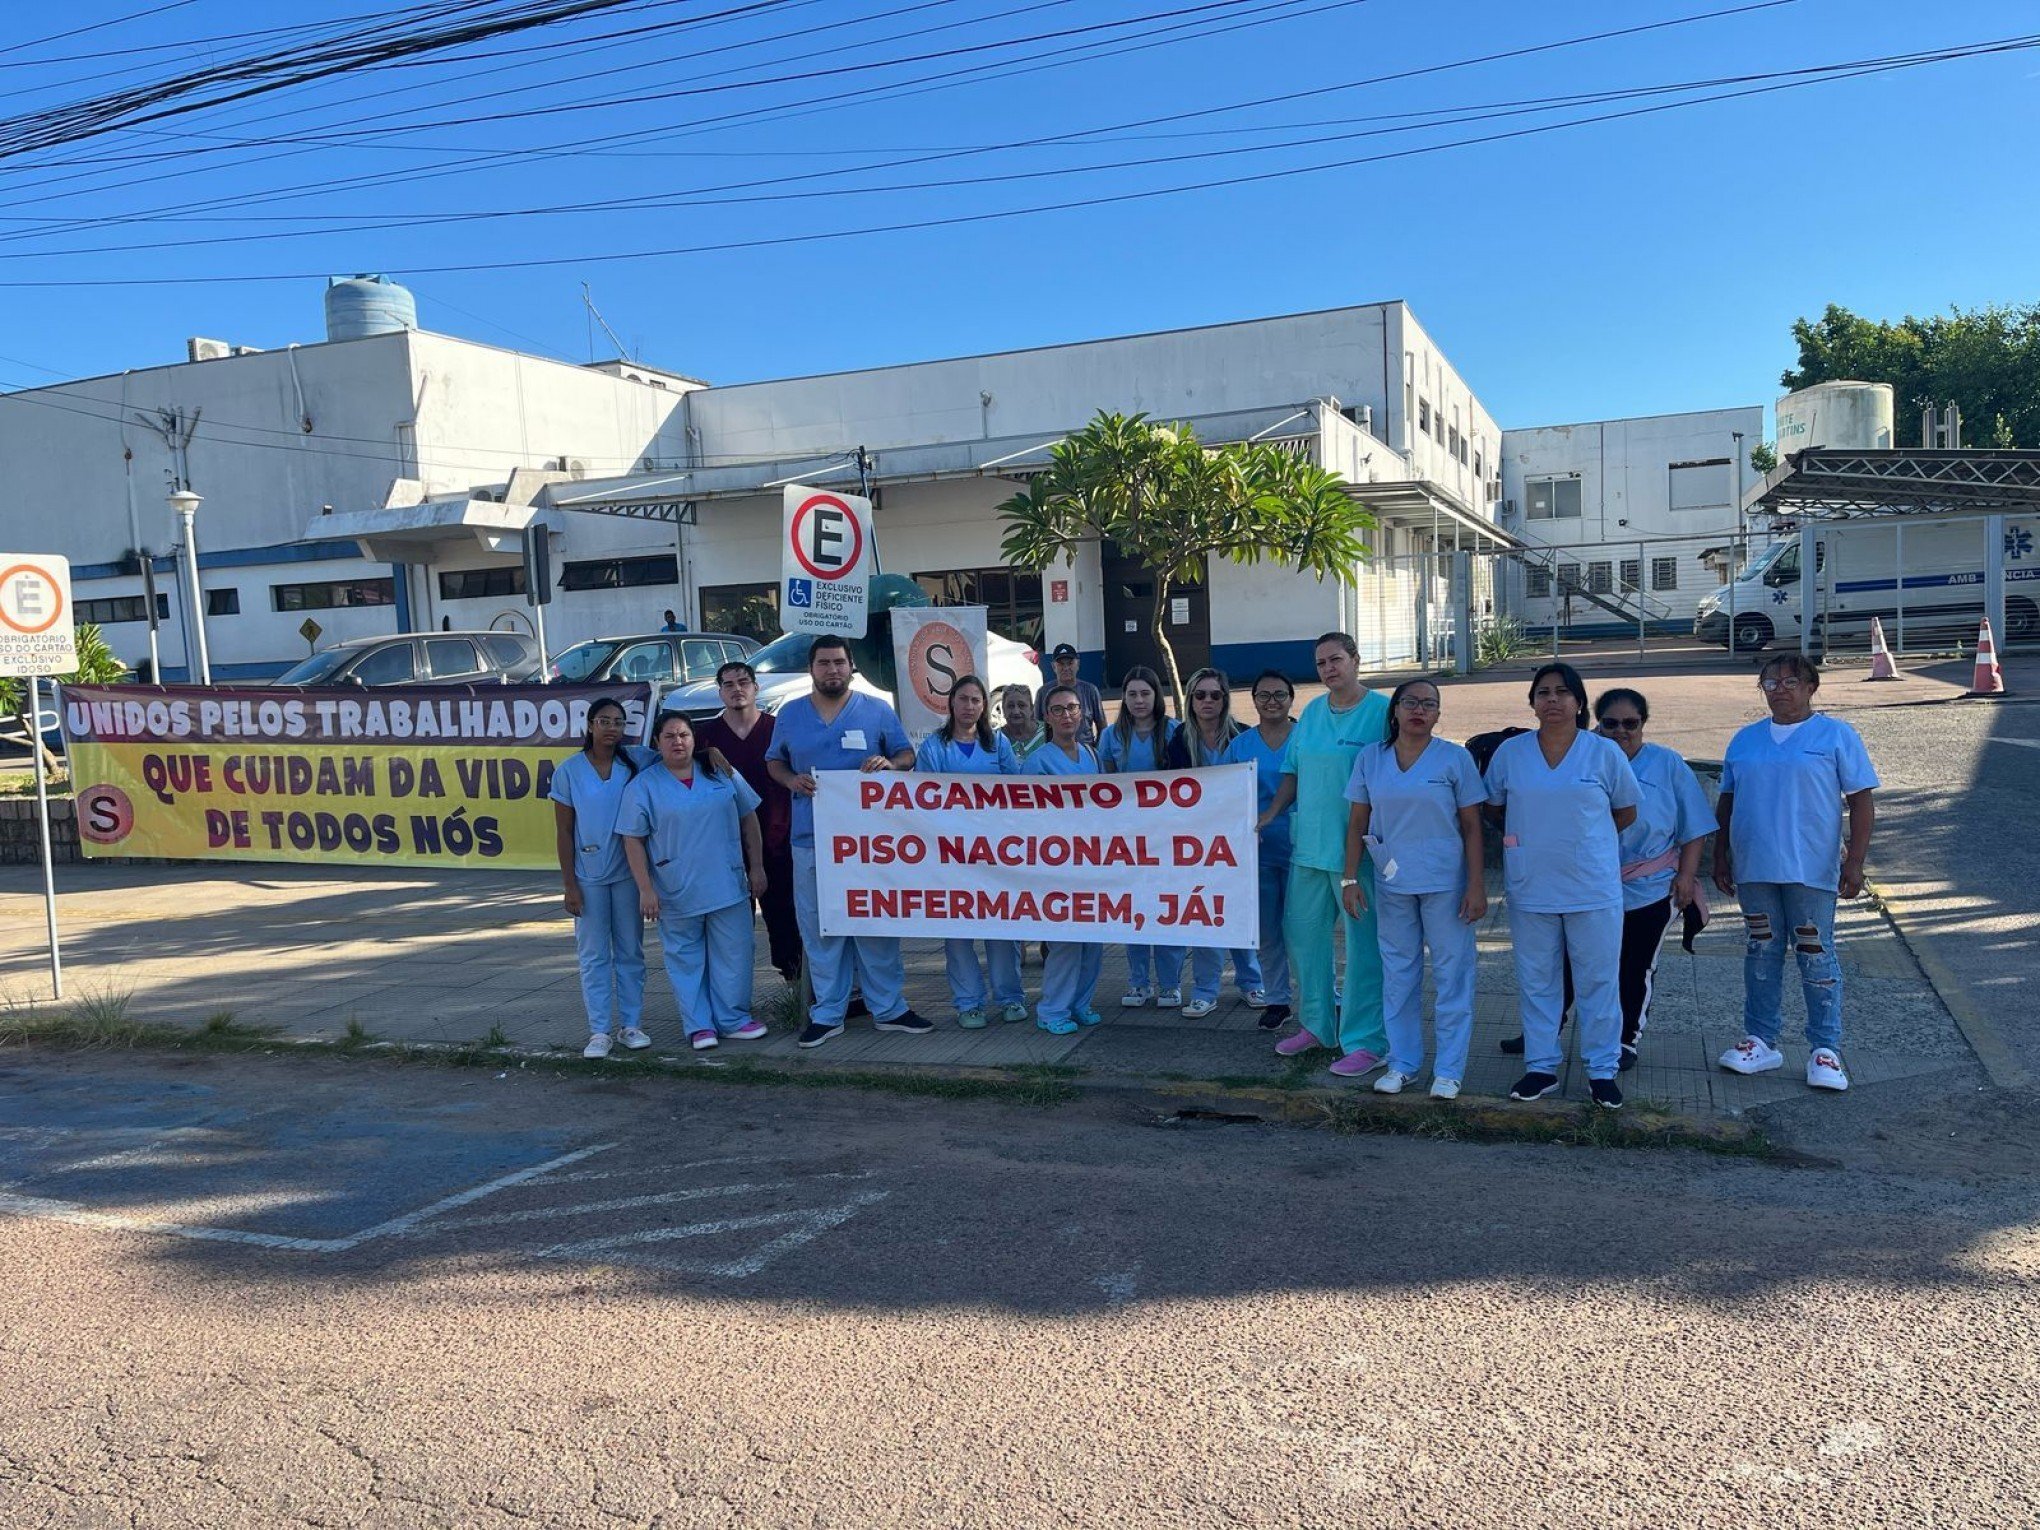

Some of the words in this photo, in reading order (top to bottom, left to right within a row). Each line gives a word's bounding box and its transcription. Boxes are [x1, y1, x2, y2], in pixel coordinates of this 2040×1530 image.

[813, 509, 843, 565] E
[816, 581, 863, 594] EXCLUSIVO
[1948, 570, 2036, 585] AMBNCIA
[15, 580, 42, 614] E
[815, 591, 864, 604] DEFICIENTE
[0, 644, 12, 653] SO
[16, 644, 31, 653] DO
[3, 654, 62, 664] EXCLUSIVO
[17, 664, 52, 674] IDOSO
[926, 643, 957, 696] S
[67, 700, 191, 737] UNIDOS
[200, 700, 307, 737] PELOS
[315, 700, 646, 738] TRABALHADORS
[143, 754, 213, 805] QUE
[223, 756, 376, 797] CUIDAM
[388, 757, 446, 798] DA
[860, 780, 1123, 811] PAGAMENTO
[1134, 776, 1202, 809] DO
[90, 796, 120, 833] S
[205, 809, 252, 849] DE
[261, 811, 401, 854] TODOS
[410, 806, 504, 858] NÓS
[832, 834, 927, 865] PISO
[937, 834, 1160, 867] NACIONAL
[1172, 834, 1238, 868] DA
[846, 888, 1145, 931] ENFERMAGEM,
[1156, 885, 1225, 928] JÁ!
